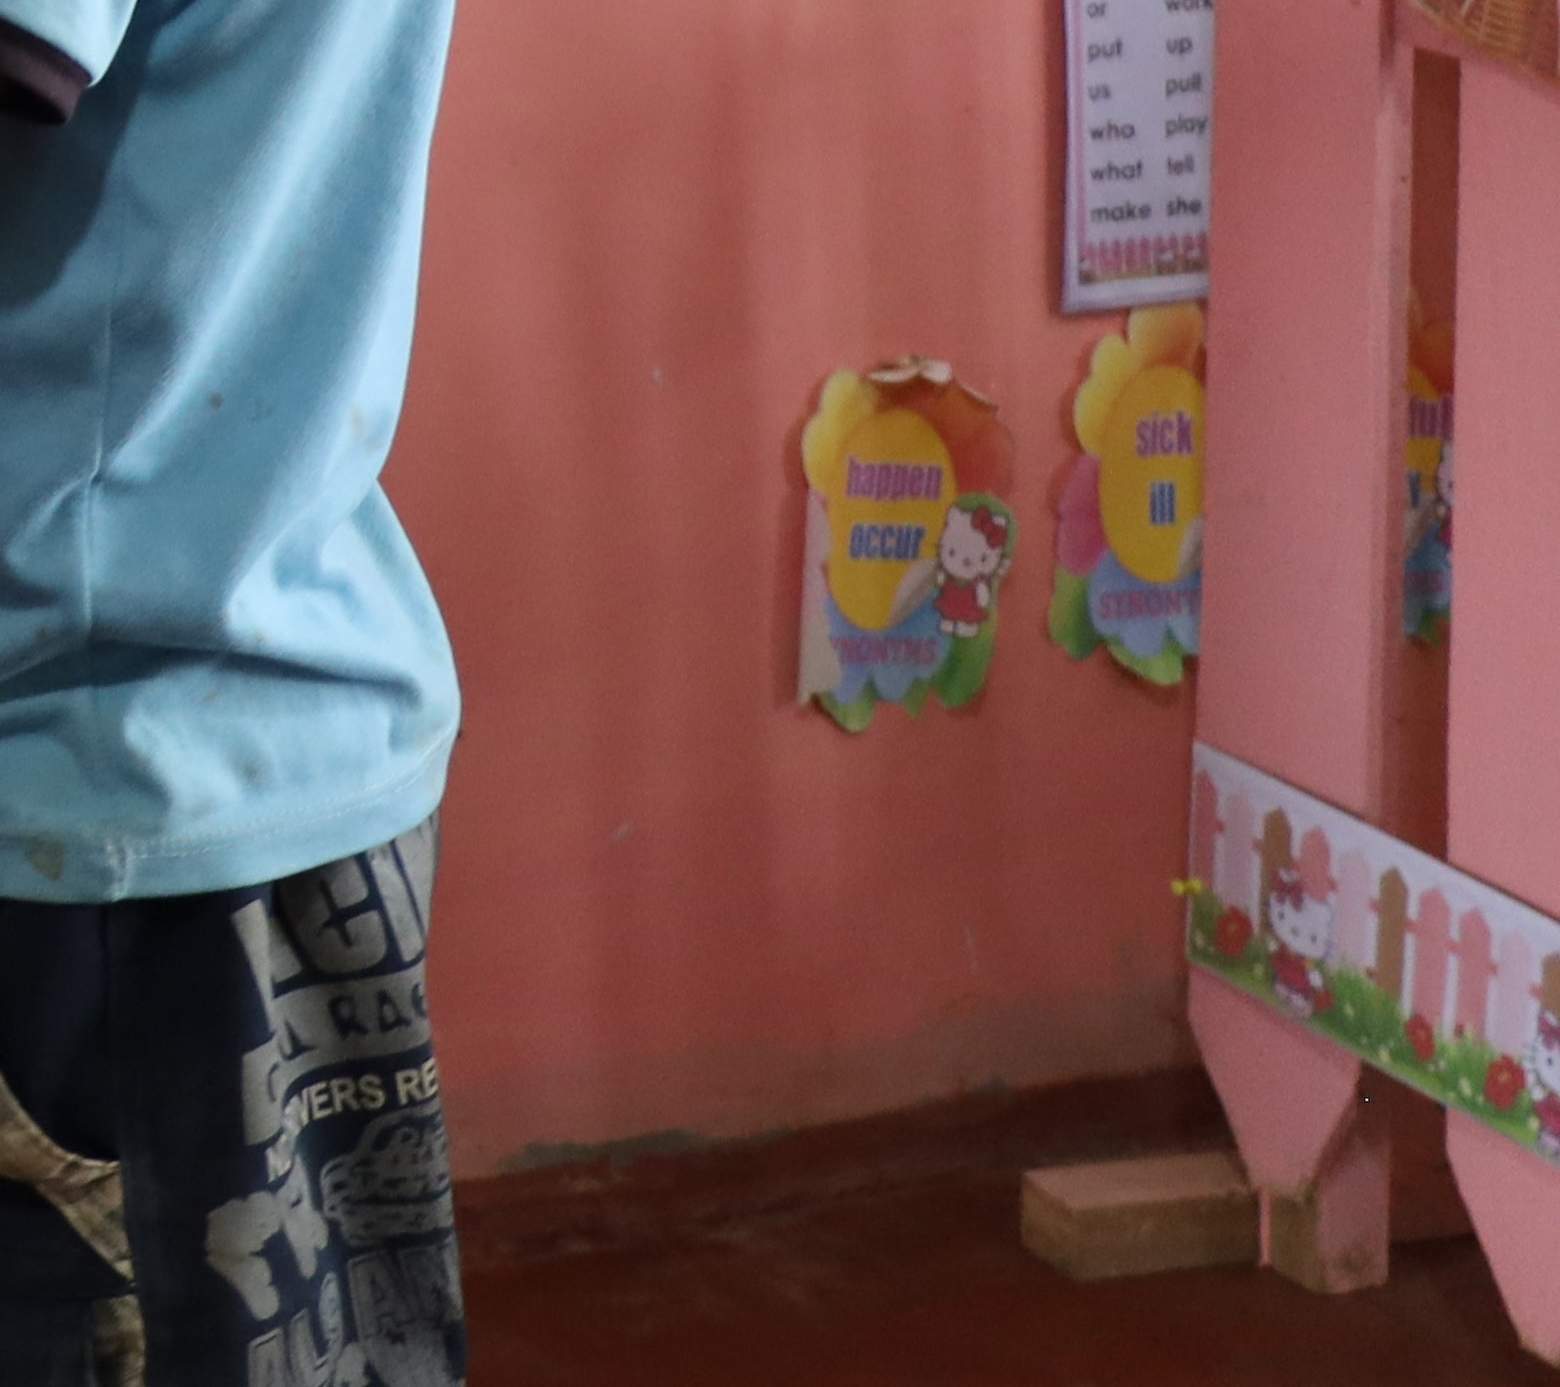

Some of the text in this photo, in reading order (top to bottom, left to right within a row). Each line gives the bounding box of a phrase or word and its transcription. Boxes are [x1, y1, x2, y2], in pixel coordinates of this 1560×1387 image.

[1087, 1, 1107, 18] or
[1088, 37, 1193, 62] put up
[1088, 72, 1202, 101] us pull
[1090, 116, 1208, 140] who play
[1090, 155, 1194, 181] what tell
[1090, 197, 1202, 222] make she
[1136, 409, 1195, 458] sick
[846, 452, 944, 503] happen
[1150, 480, 1177, 525] ill
[849, 522, 927, 561] occur
